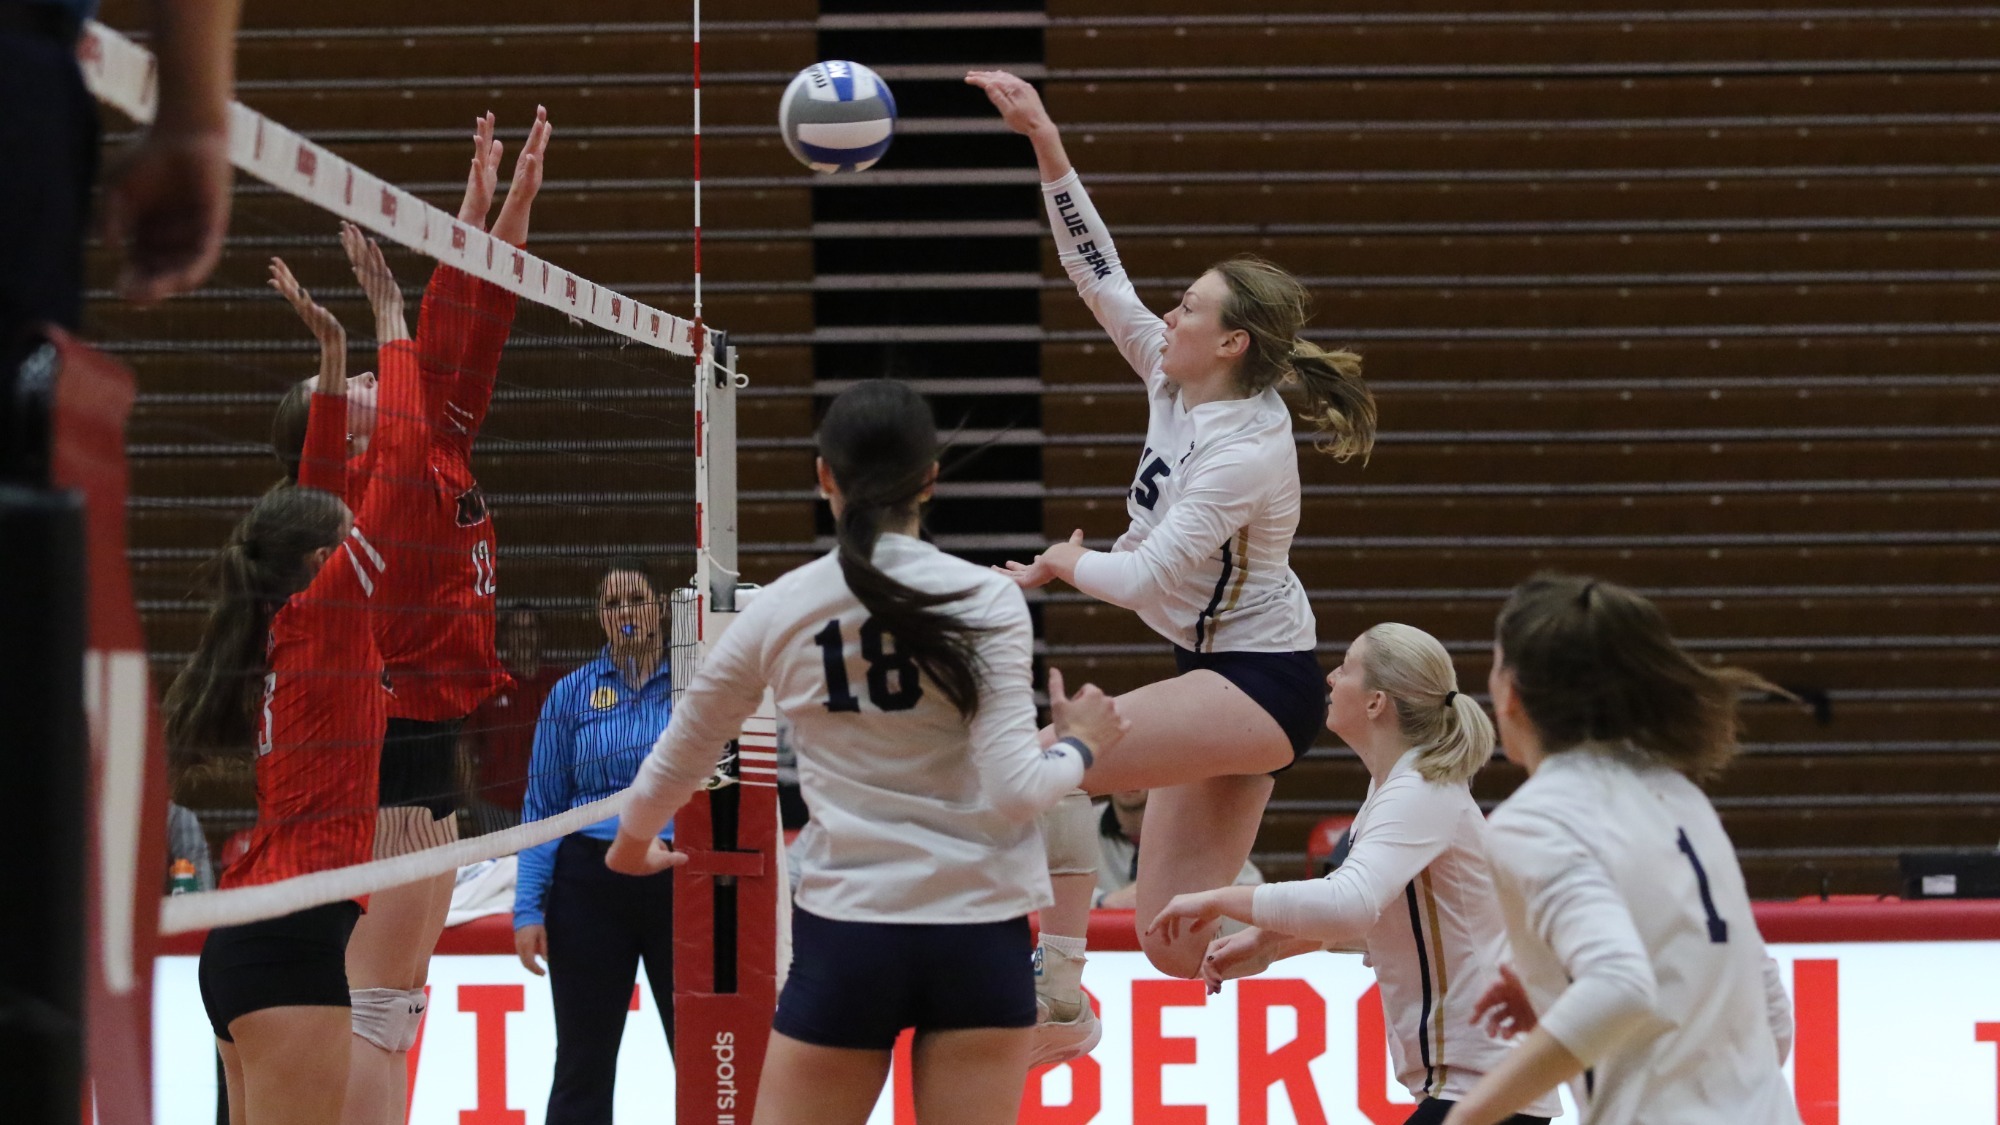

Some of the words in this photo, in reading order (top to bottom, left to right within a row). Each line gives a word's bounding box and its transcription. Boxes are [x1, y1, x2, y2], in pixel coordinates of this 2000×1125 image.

[1054, 190, 1089, 237] BLUE
[472, 539, 497, 598] 12
[814, 615, 924, 712] 18
[1676, 826, 1728, 944] 1
[711, 1031, 738, 1110] sports
